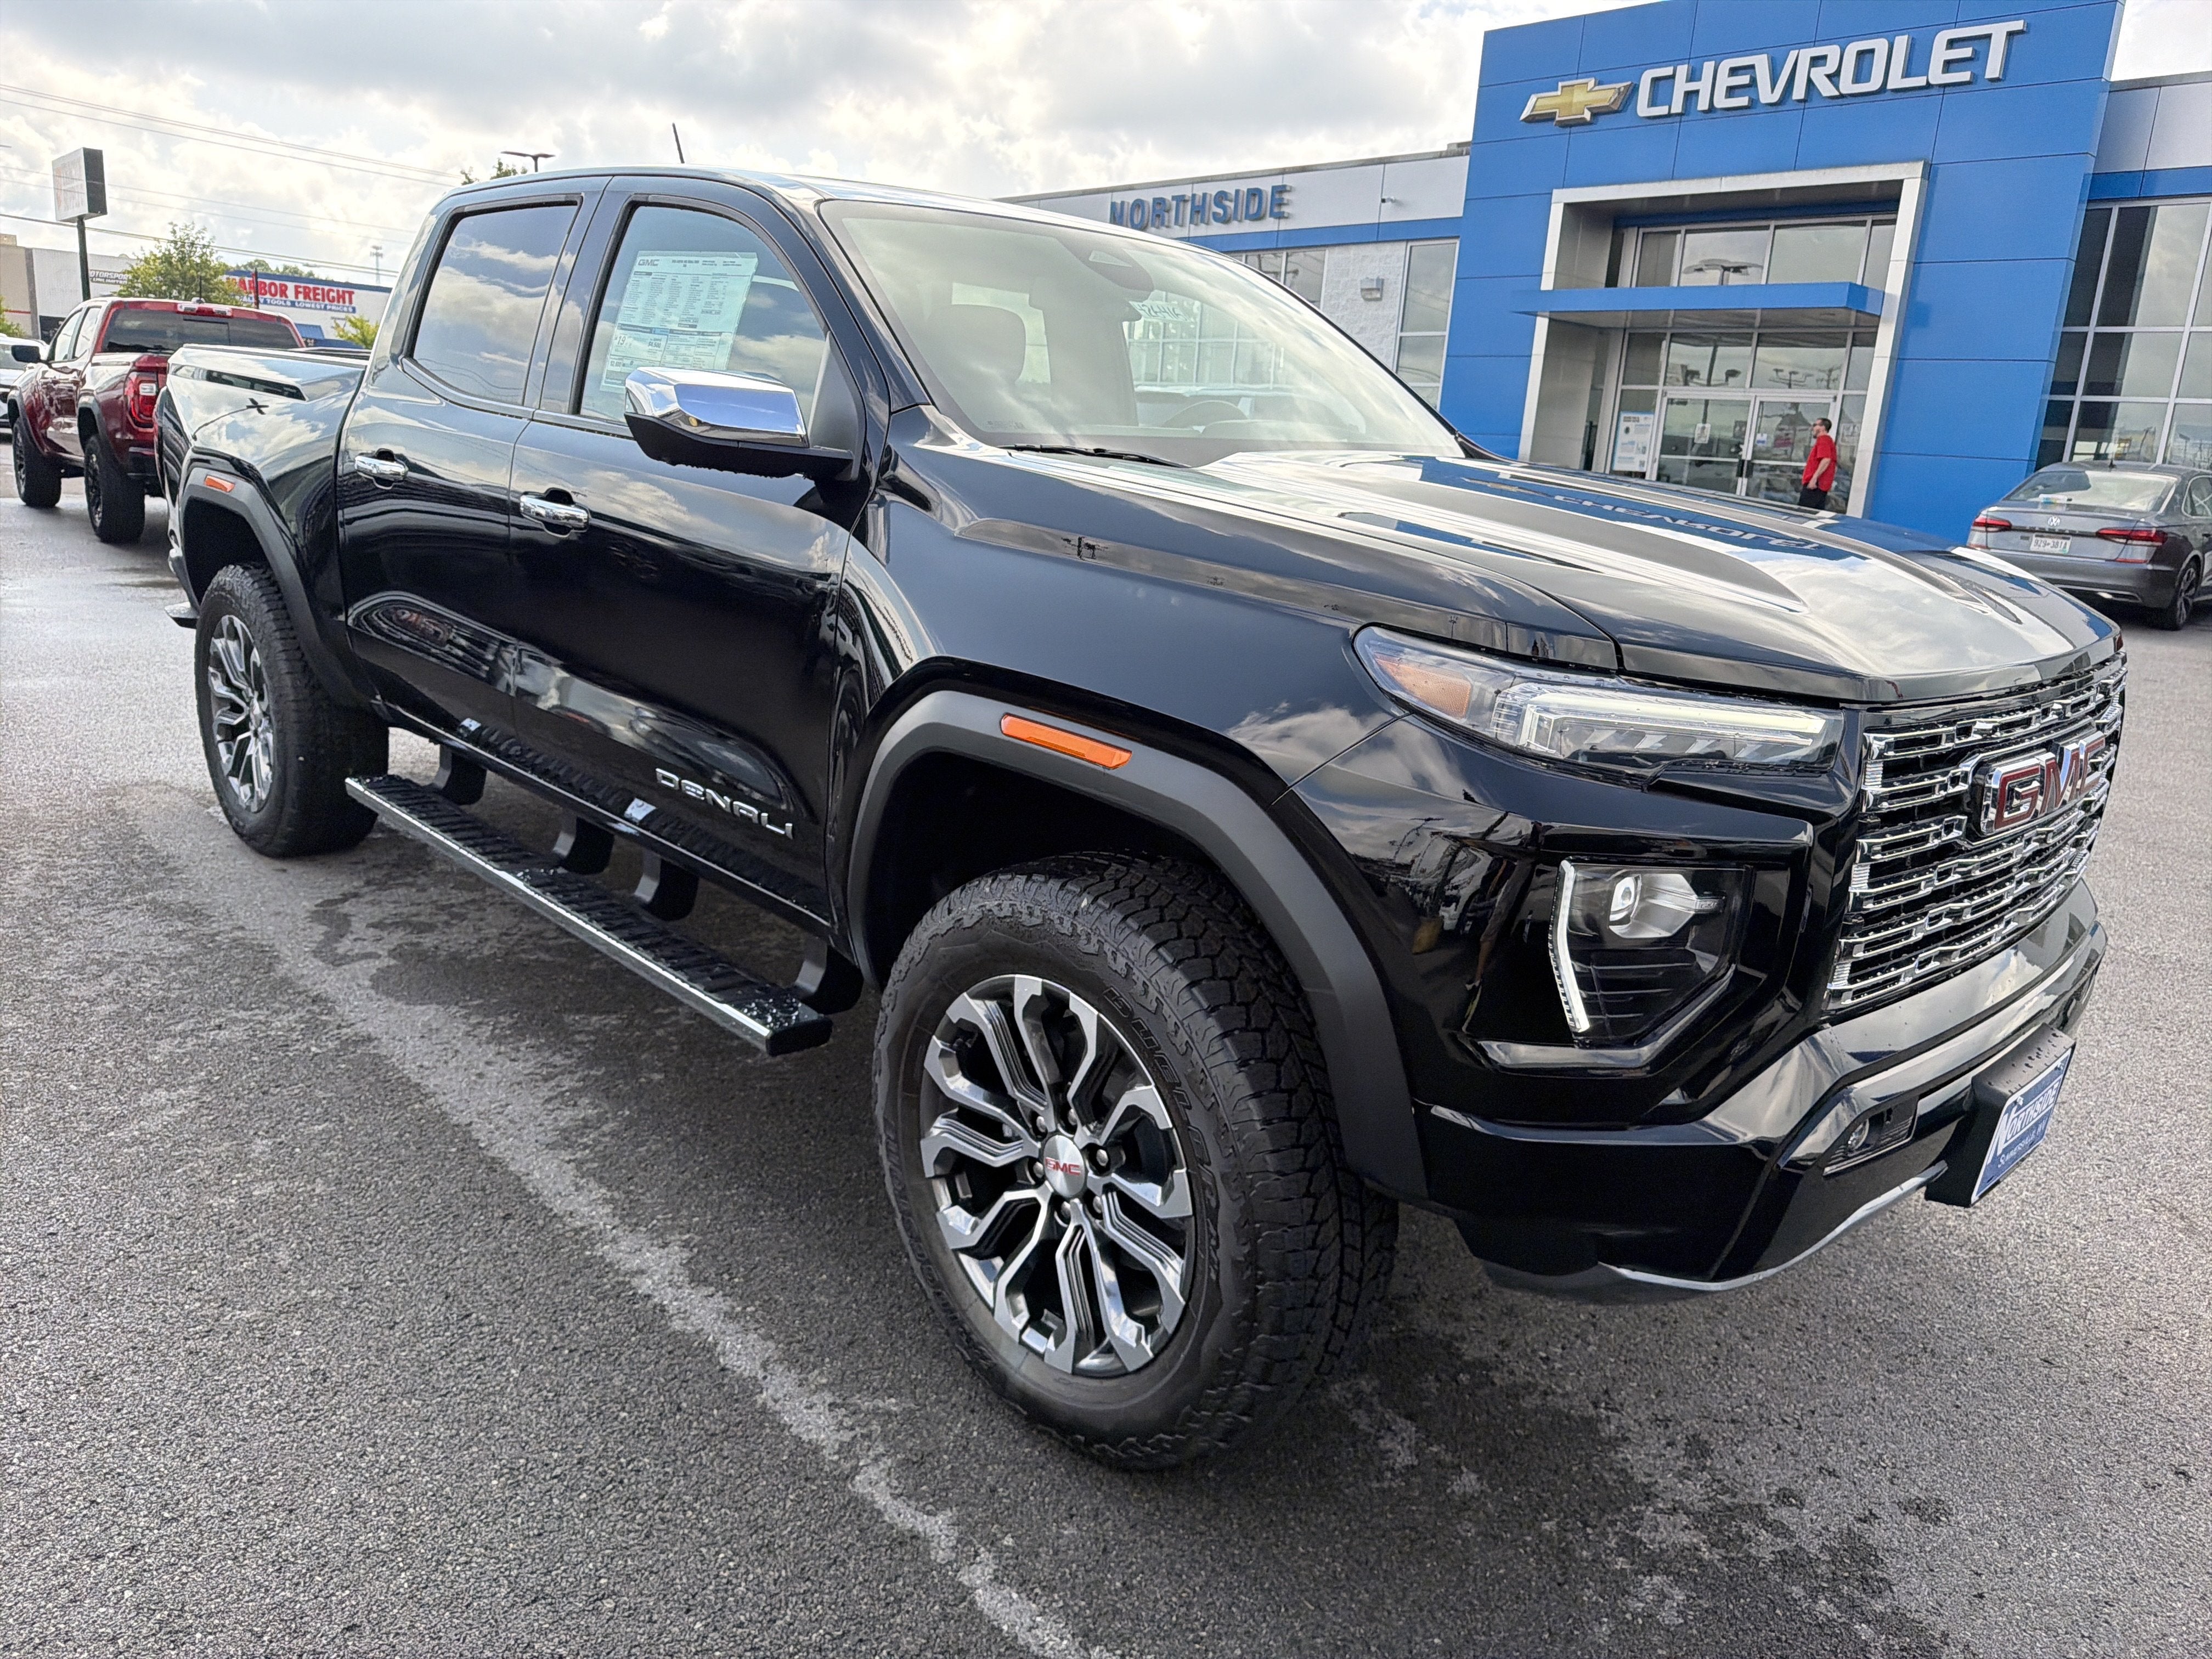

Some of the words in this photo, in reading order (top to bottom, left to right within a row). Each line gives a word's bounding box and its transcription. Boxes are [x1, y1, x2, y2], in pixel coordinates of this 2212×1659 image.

[1637, 19, 2028, 119] CHEVROLET
[1110, 184, 1293, 230] NORTHSIDE
[294, 284, 355, 305] FREIGHT
[656, 768, 793, 839] DENALI
[1981, 731, 2106, 832] GMC
[1987, 1079, 2059, 1165] NORTHSIDE
[1045, 1157, 1081, 1177] GMC
